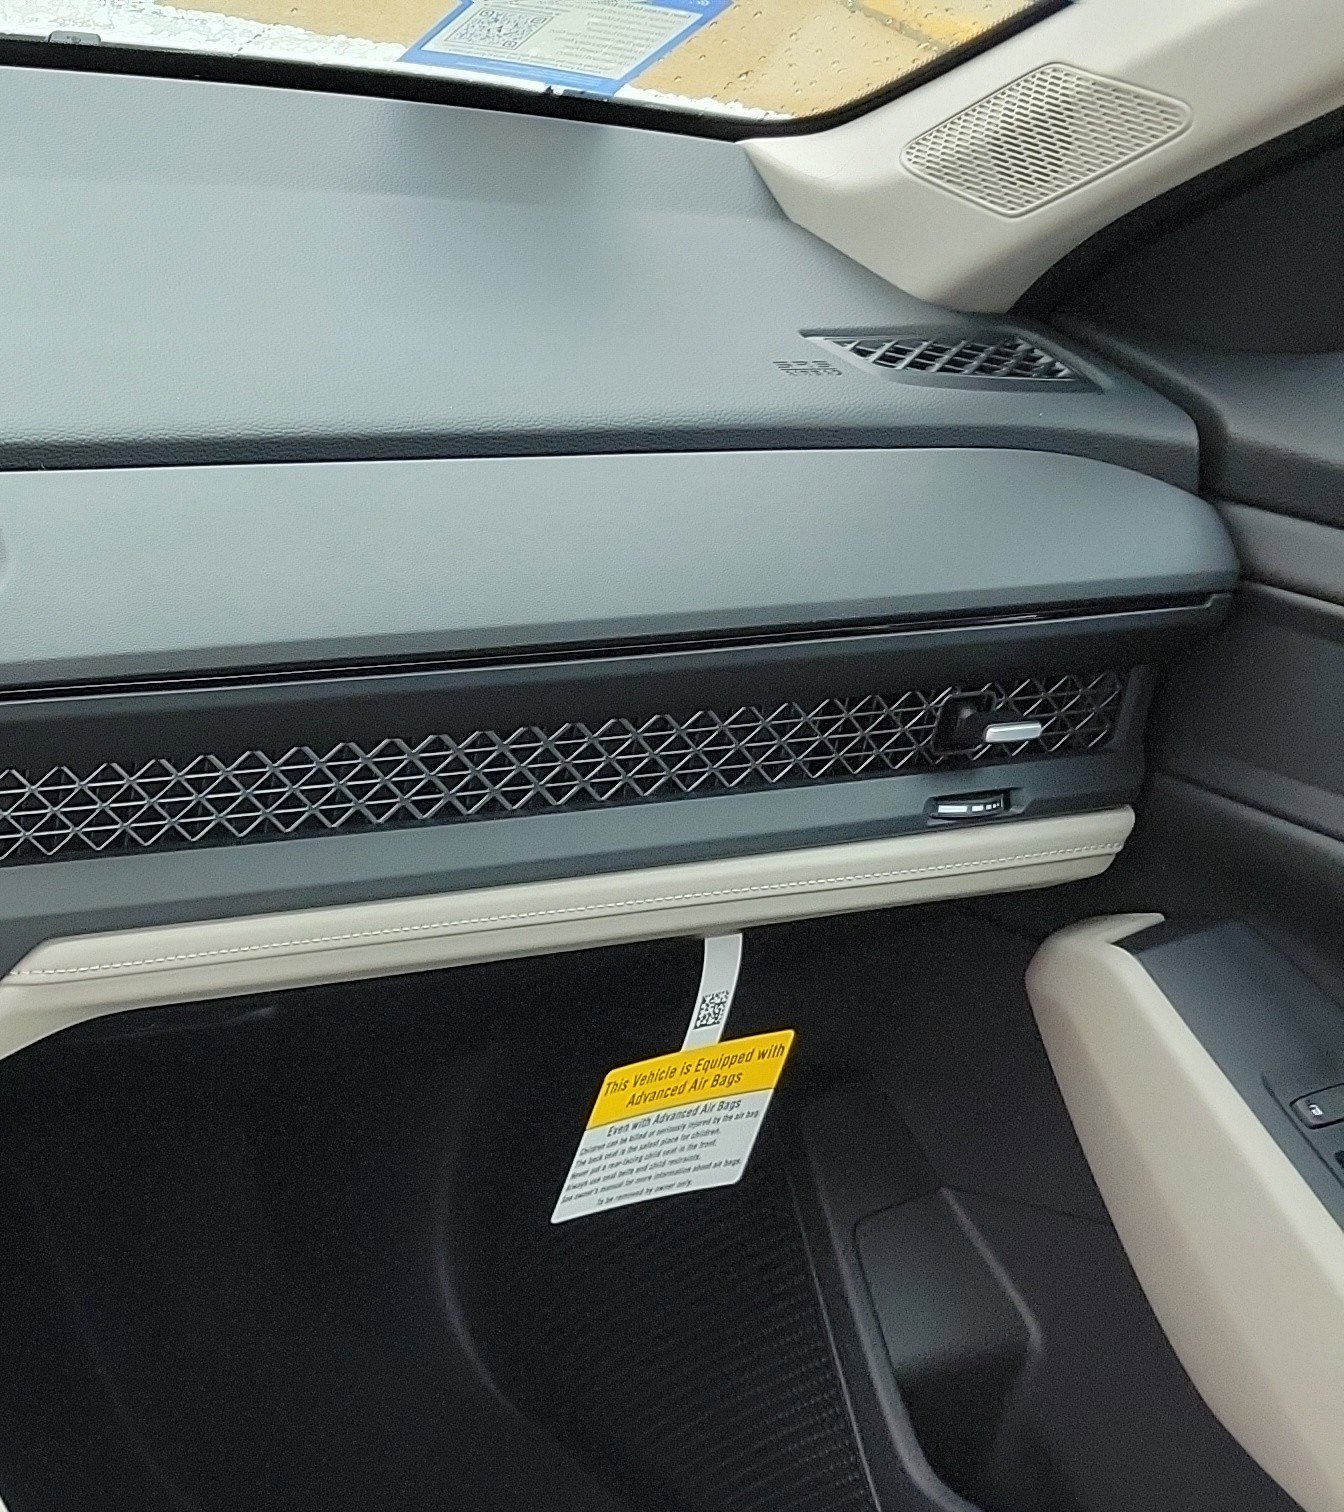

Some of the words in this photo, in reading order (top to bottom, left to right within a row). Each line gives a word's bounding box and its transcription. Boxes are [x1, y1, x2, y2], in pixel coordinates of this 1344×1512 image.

[604, 1081, 628, 1097] This
[633, 1067, 677, 1087] Vehicle
[680, 1062, 692, 1076] is
[695, 1049, 754, 1073] Equipped
[757, 1043, 785, 1061] with
[626, 1081, 689, 1108] Advanced
[689, 1074, 706, 1092] Air
[710, 1072, 743, 1088] Bags
[607, 1123, 630, 1137] Even
[653, 1106, 700, 1124] Advanced
[701, 1103, 715, 1114] Air
[717, 1100, 742, 1111] Bags
